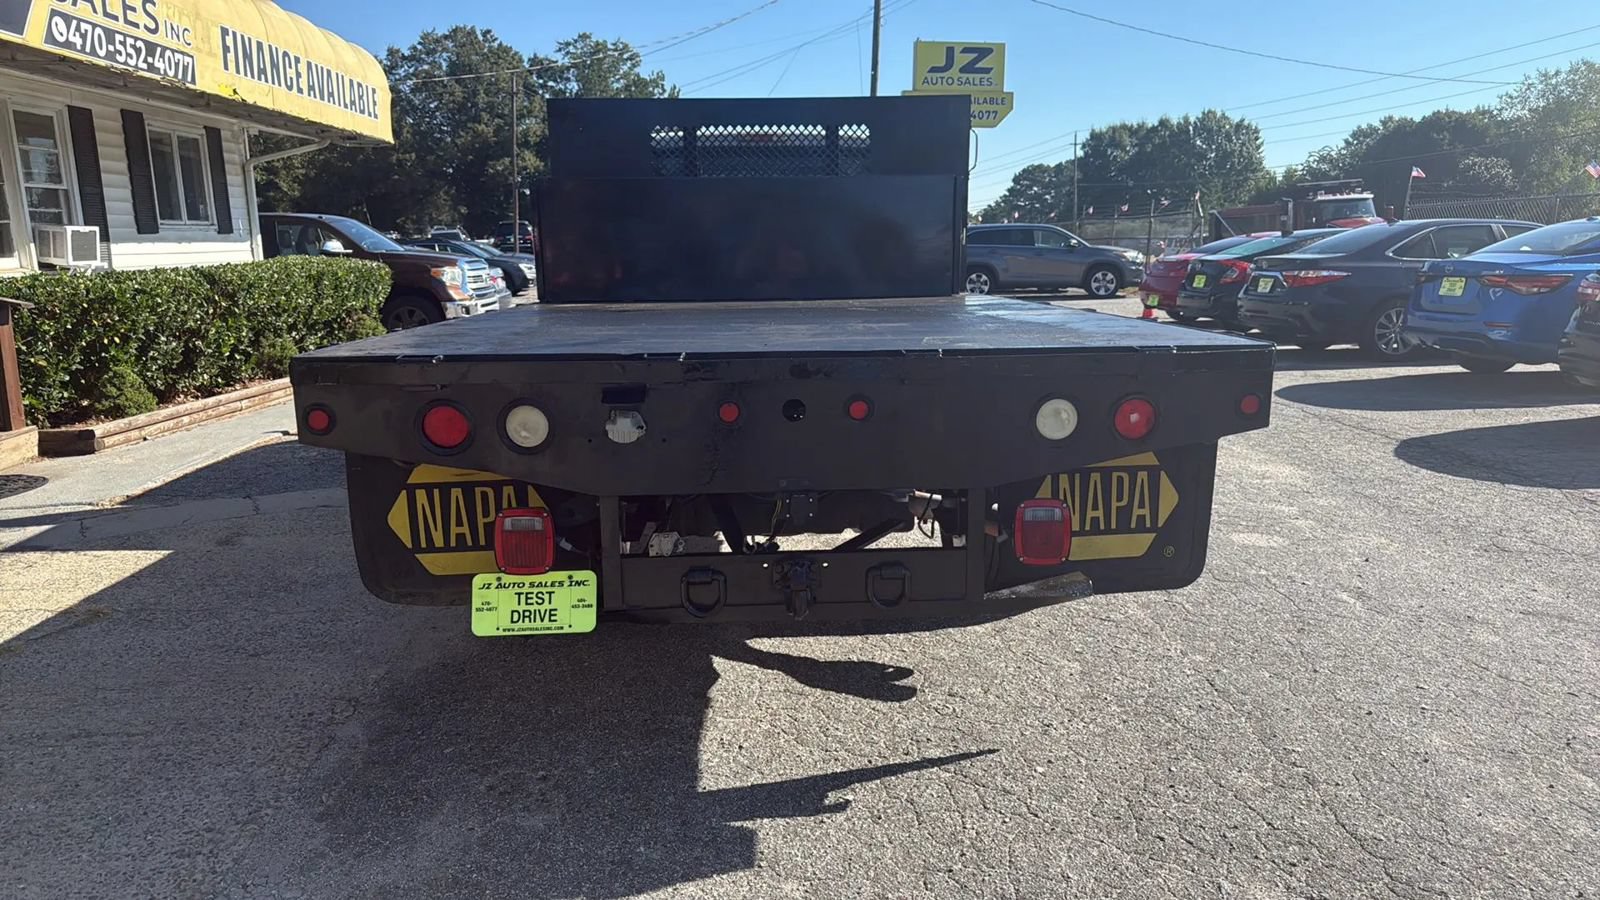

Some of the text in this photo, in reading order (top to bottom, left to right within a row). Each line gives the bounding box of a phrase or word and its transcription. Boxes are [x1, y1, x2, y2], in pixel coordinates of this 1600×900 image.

[55, 0, 192, 46] LES INC
[68, 20, 193, 82] 470-552-4077
[927, 46, 994, 74] JZ
[220, 25, 378, 119] FINANCE AVAILABLE
[921, 76, 954, 86] AUTO
[956, 77, 993, 87] SALES
[970, 96, 1007, 106] ILABLE
[970, 110, 998, 121] 4077
[1058, 470, 1151, 531] NAPA
[495, 581, 525, 590] AUTO
[528, 580, 565, 588] SALES
[567, 579, 590, 588] INC.
[514, 591, 555, 606] TEST
[510, 608, 558, 624] DRIVE
